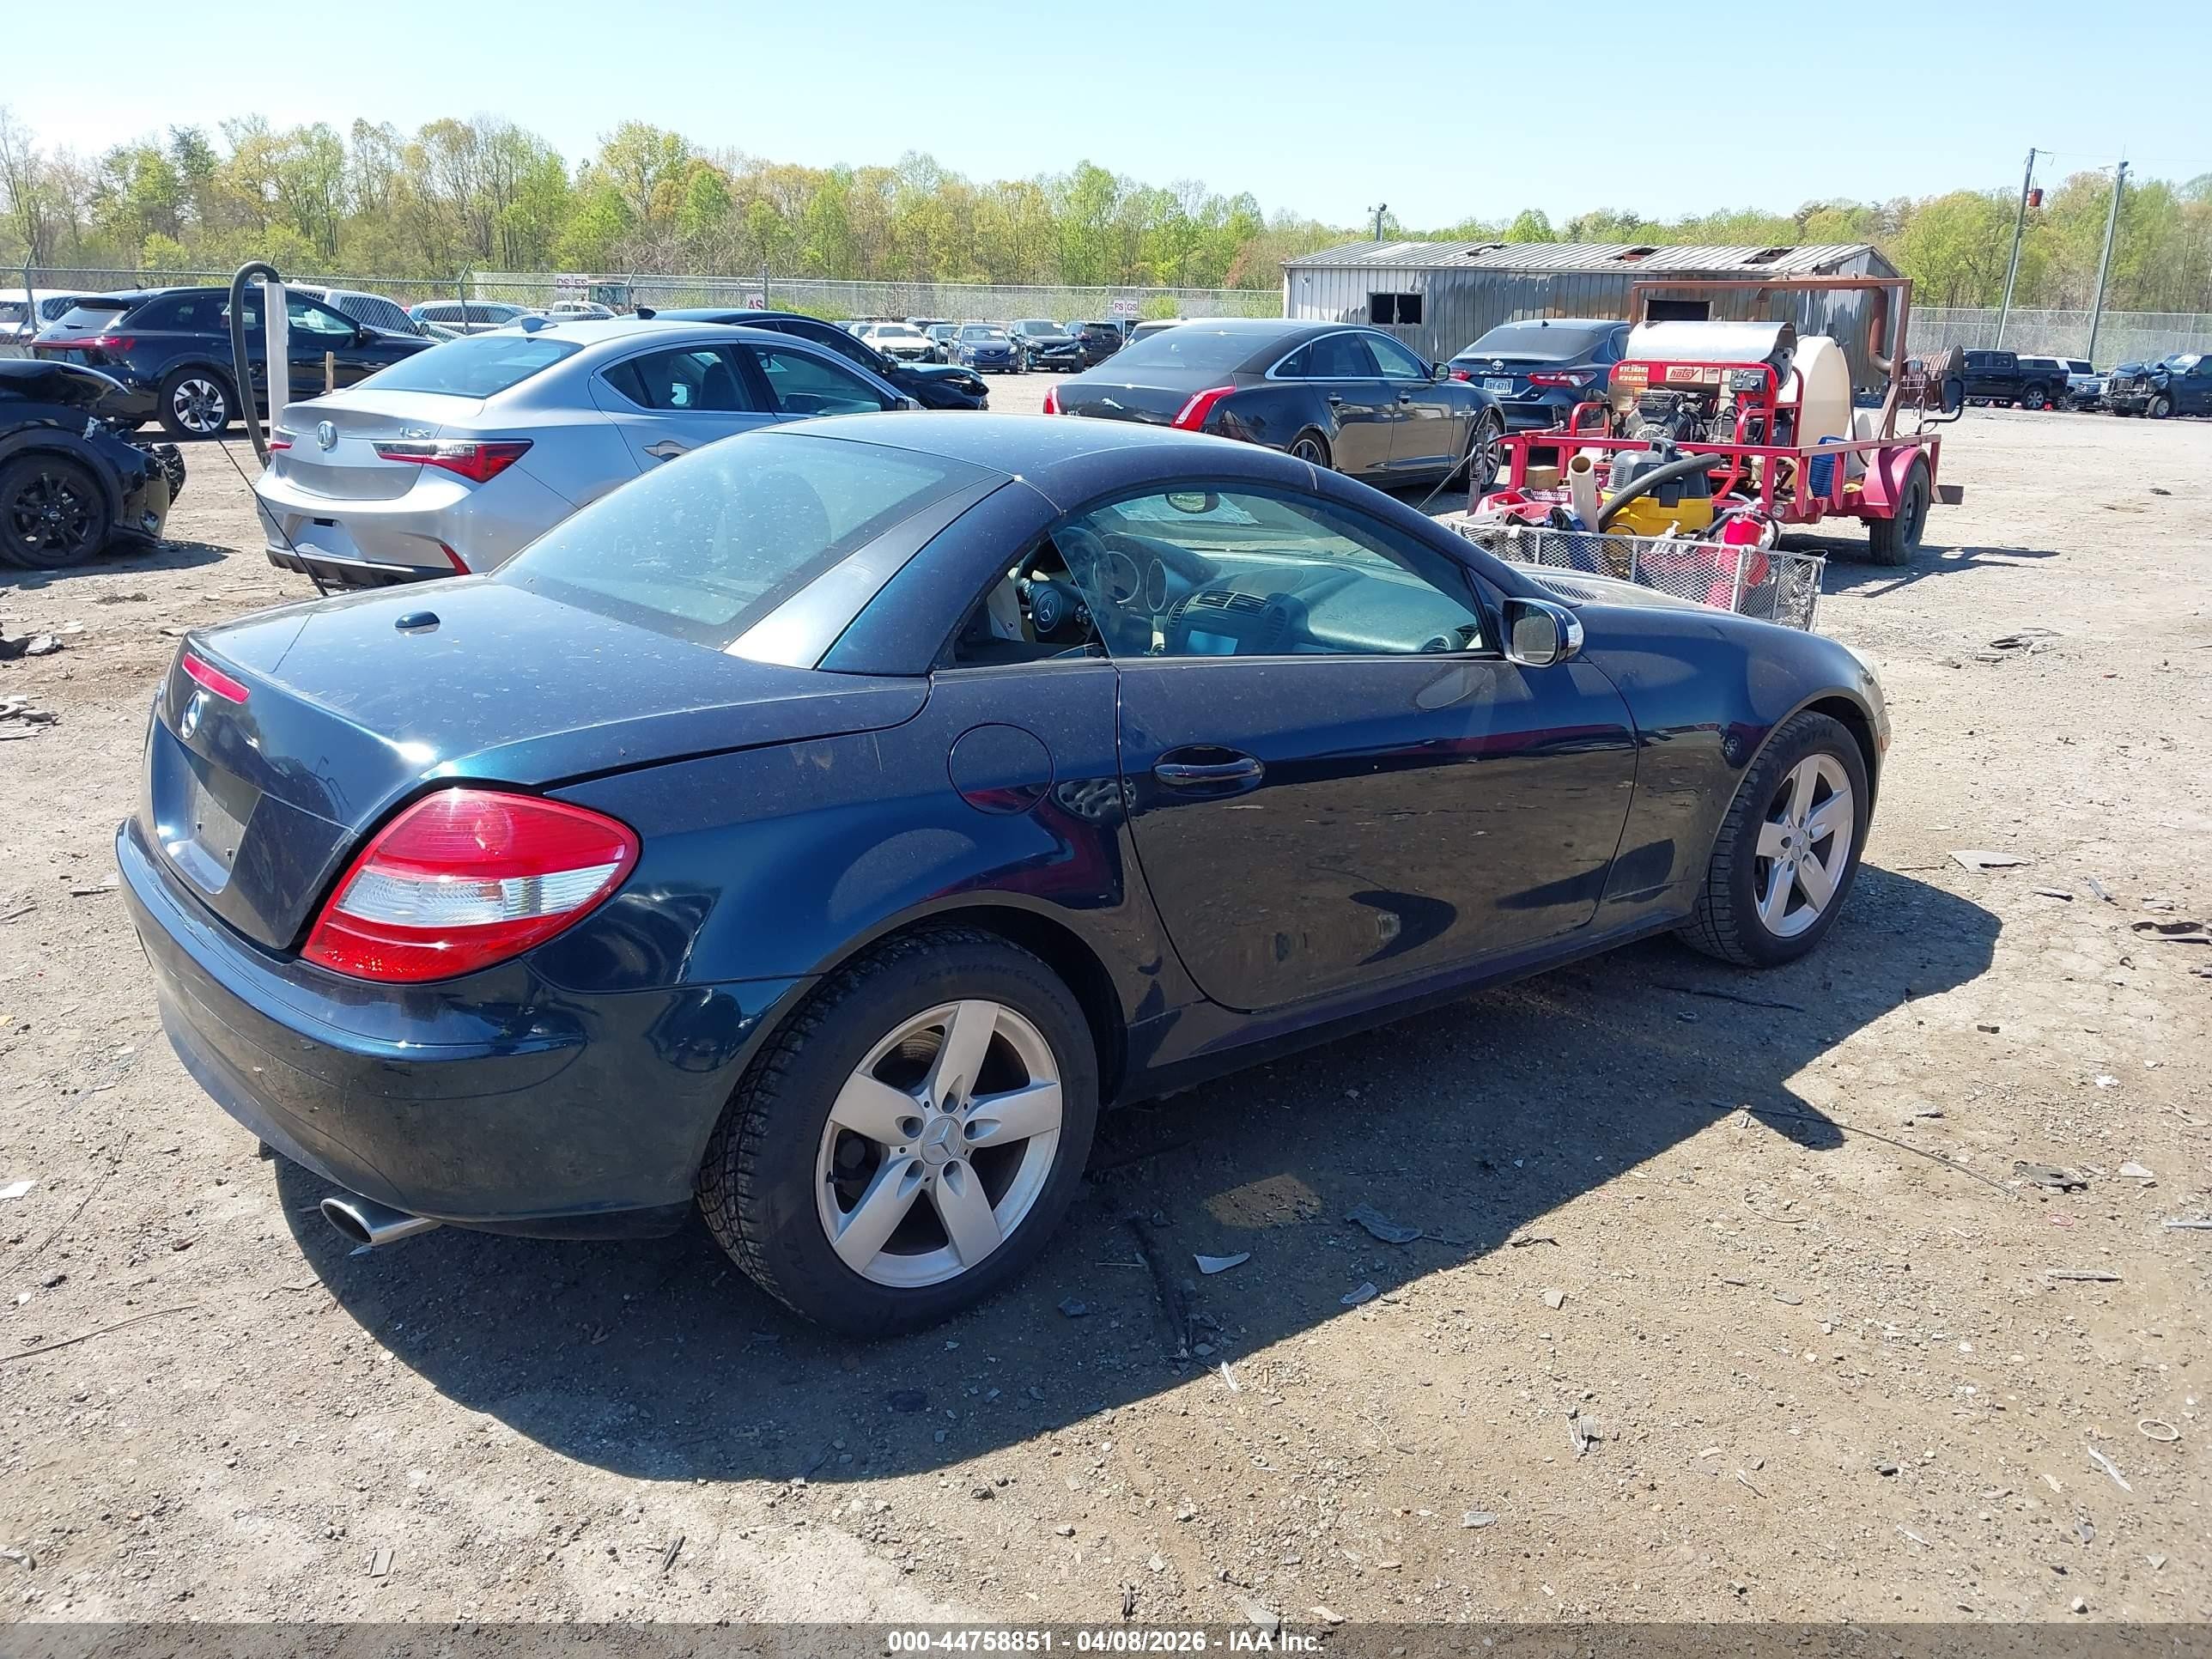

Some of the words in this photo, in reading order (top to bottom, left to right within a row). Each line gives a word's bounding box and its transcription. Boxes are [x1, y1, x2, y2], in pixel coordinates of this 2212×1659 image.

[749, 300, 763, 309] AS
[1669, 368, 1700, 380] hotsy
[398, 427, 430, 438] ILX
